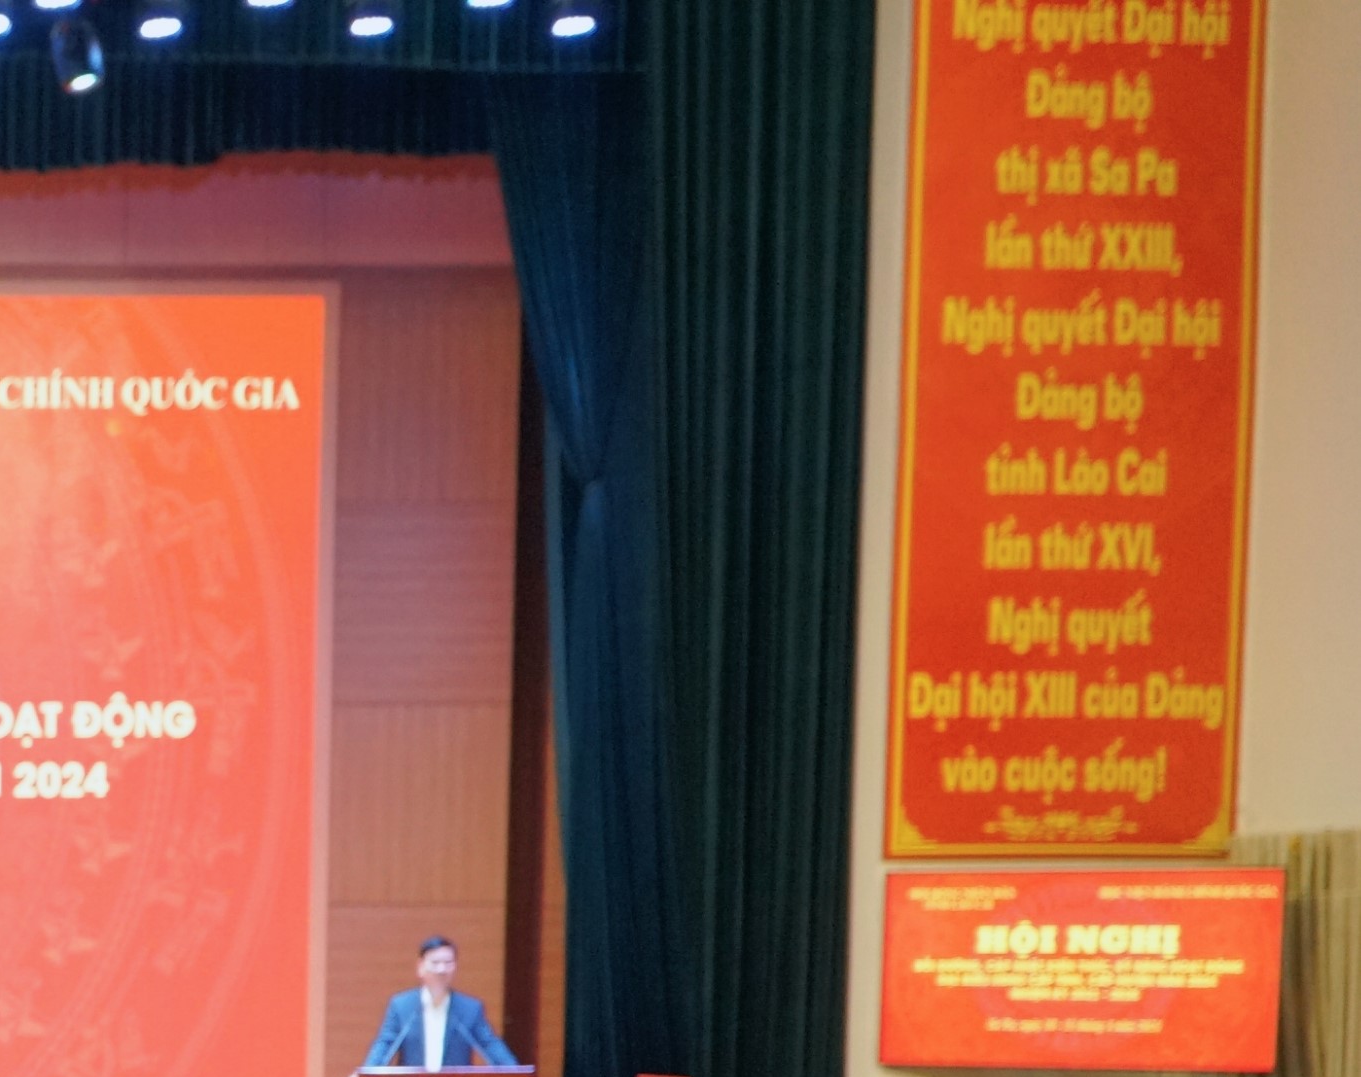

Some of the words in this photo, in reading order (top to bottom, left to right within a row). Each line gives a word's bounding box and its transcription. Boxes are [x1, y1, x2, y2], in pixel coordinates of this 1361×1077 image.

[952, 0, 1025, 54] Nghị
[1123, 0, 1174, 58] Đại
[1181, 0, 1230, 59] hội
[1025, 62, 1106, 129] Đảng
[1112, 70, 1153, 134] bộ
[995, 144, 1039, 206] thị
[1045, 146, 1082, 194] xã
[1089, 146, 1130, 195] Sa
[1135, 147, 1176, 195] Pa
[1040, 221, 1095, 270] thứ
[1099, 222, 1184, 278] XXIII,
[941, 295, 1015, 357] Nghị
[1021, 288, 1107, 355] quyết
[1113, 297, 1165, 360] Đại
[1172, 298, 1221, 360] hội
[121, 367, 230, 416] QUỐC
[234, 377, 301, 410] GIA
[1015, 366, 1098, 431] Đảng
[1103, 371, 1144, 434] bộ
[985, 442, 1046, 495] tỉnh
[1053, 447, 1110, 495] Lào
[1116, 447, 1168, 495] Cai
[1039, 522, 1094, 570] thứ
[1097, 522, 1162, 577] XVI,
[987, 597, 1061, 656] Nghị
[1067, 588, 1152, 655] quyết
[71, 691, 197, 748] ĐỘNG
[908, 670, 962, 732] Đại
[968, 671, 1018, 732] hội
[1023, 671, 1077, 719] XIII
[1083, 666, 1139, 719] của
[1144, 666, 1226, 731] Đảng
[12, 761, 110, 799] 2024
[940, 744, 998, 792] vào
[1004, 745, 1076, 805] cuộc
[1084, 737, 1168, 803] sống!
[975, 920, 1057, 959] HỘI
